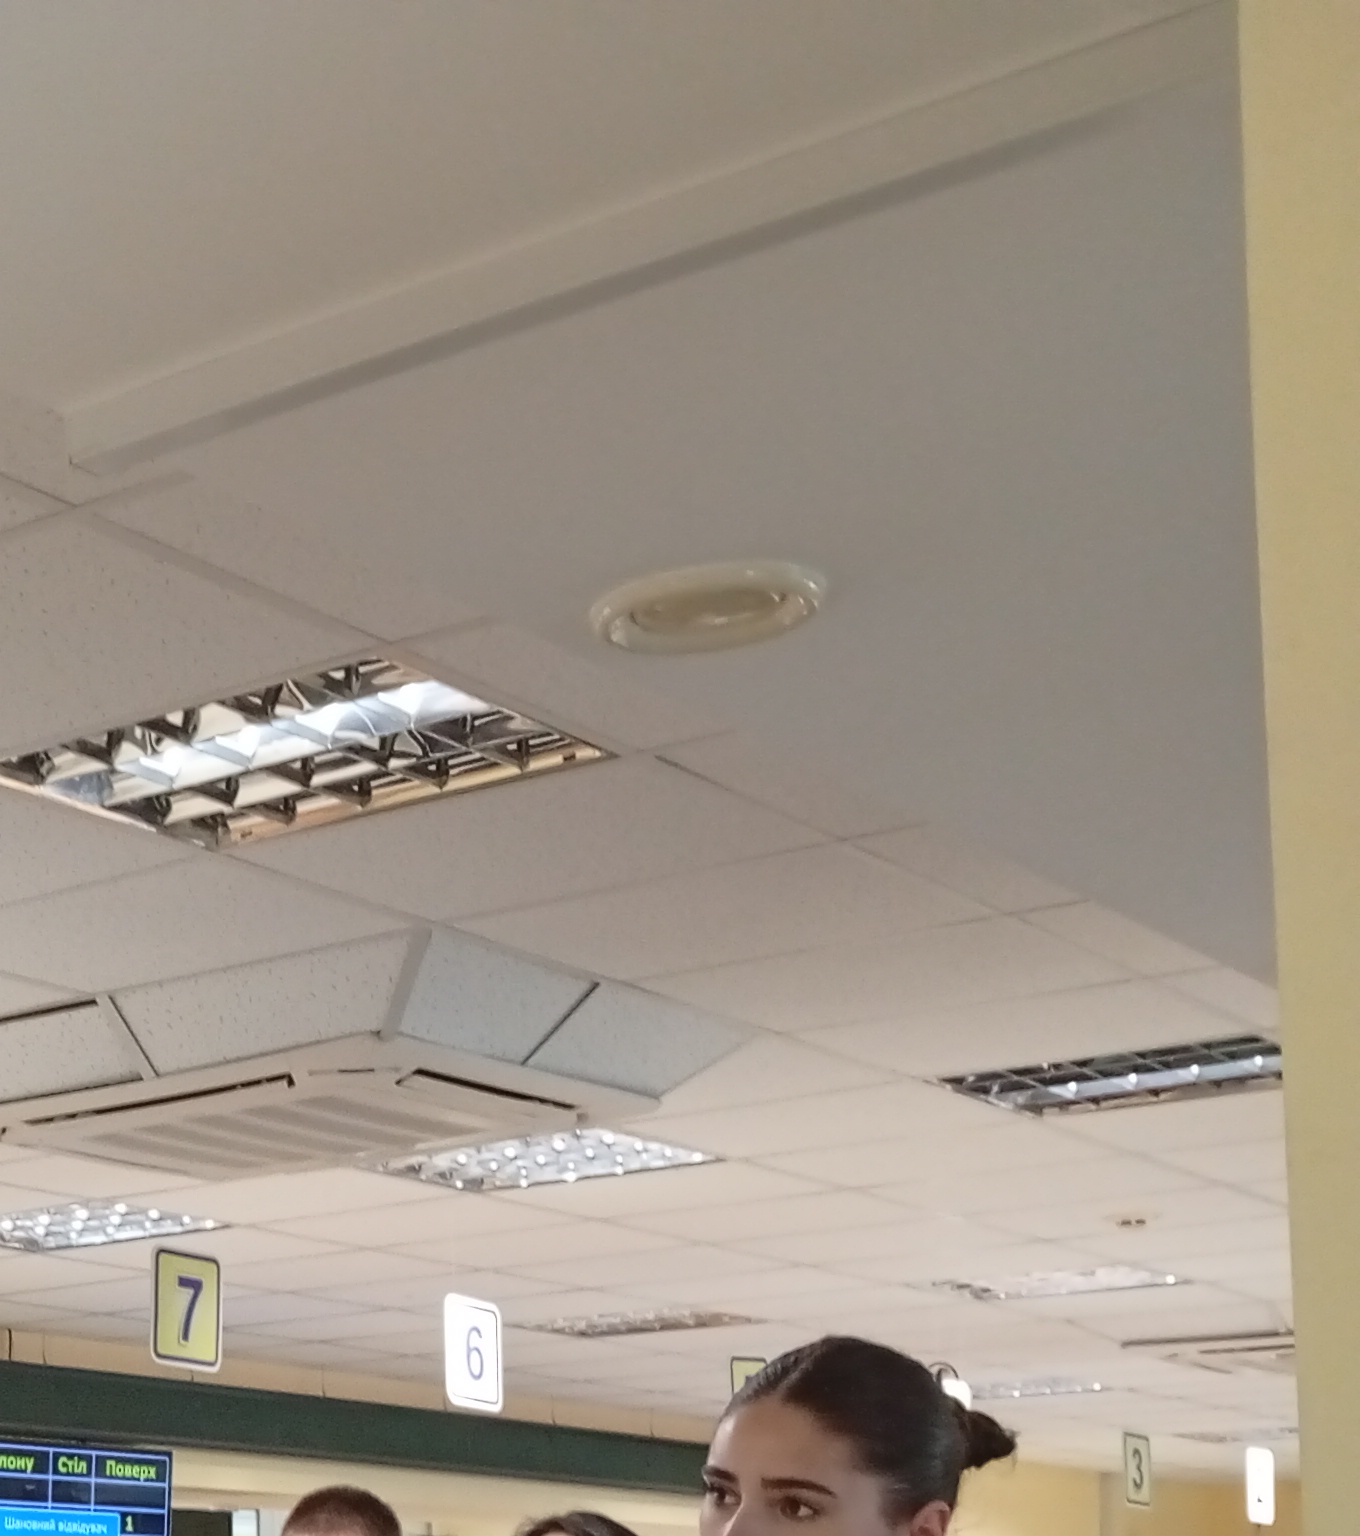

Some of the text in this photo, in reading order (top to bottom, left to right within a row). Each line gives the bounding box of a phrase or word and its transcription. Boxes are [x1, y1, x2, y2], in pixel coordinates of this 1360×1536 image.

[177, 1275, 204, 1343] 7
[466, 1326, 484, 1381] 6
[58, 1456, 88, 1475] Стіл
[106, 1459, 157, 1481] Поверх
[1132, 1447, 1144, 1490] 3
[4, 1516, 108, 1535] Шановний відвідувач
